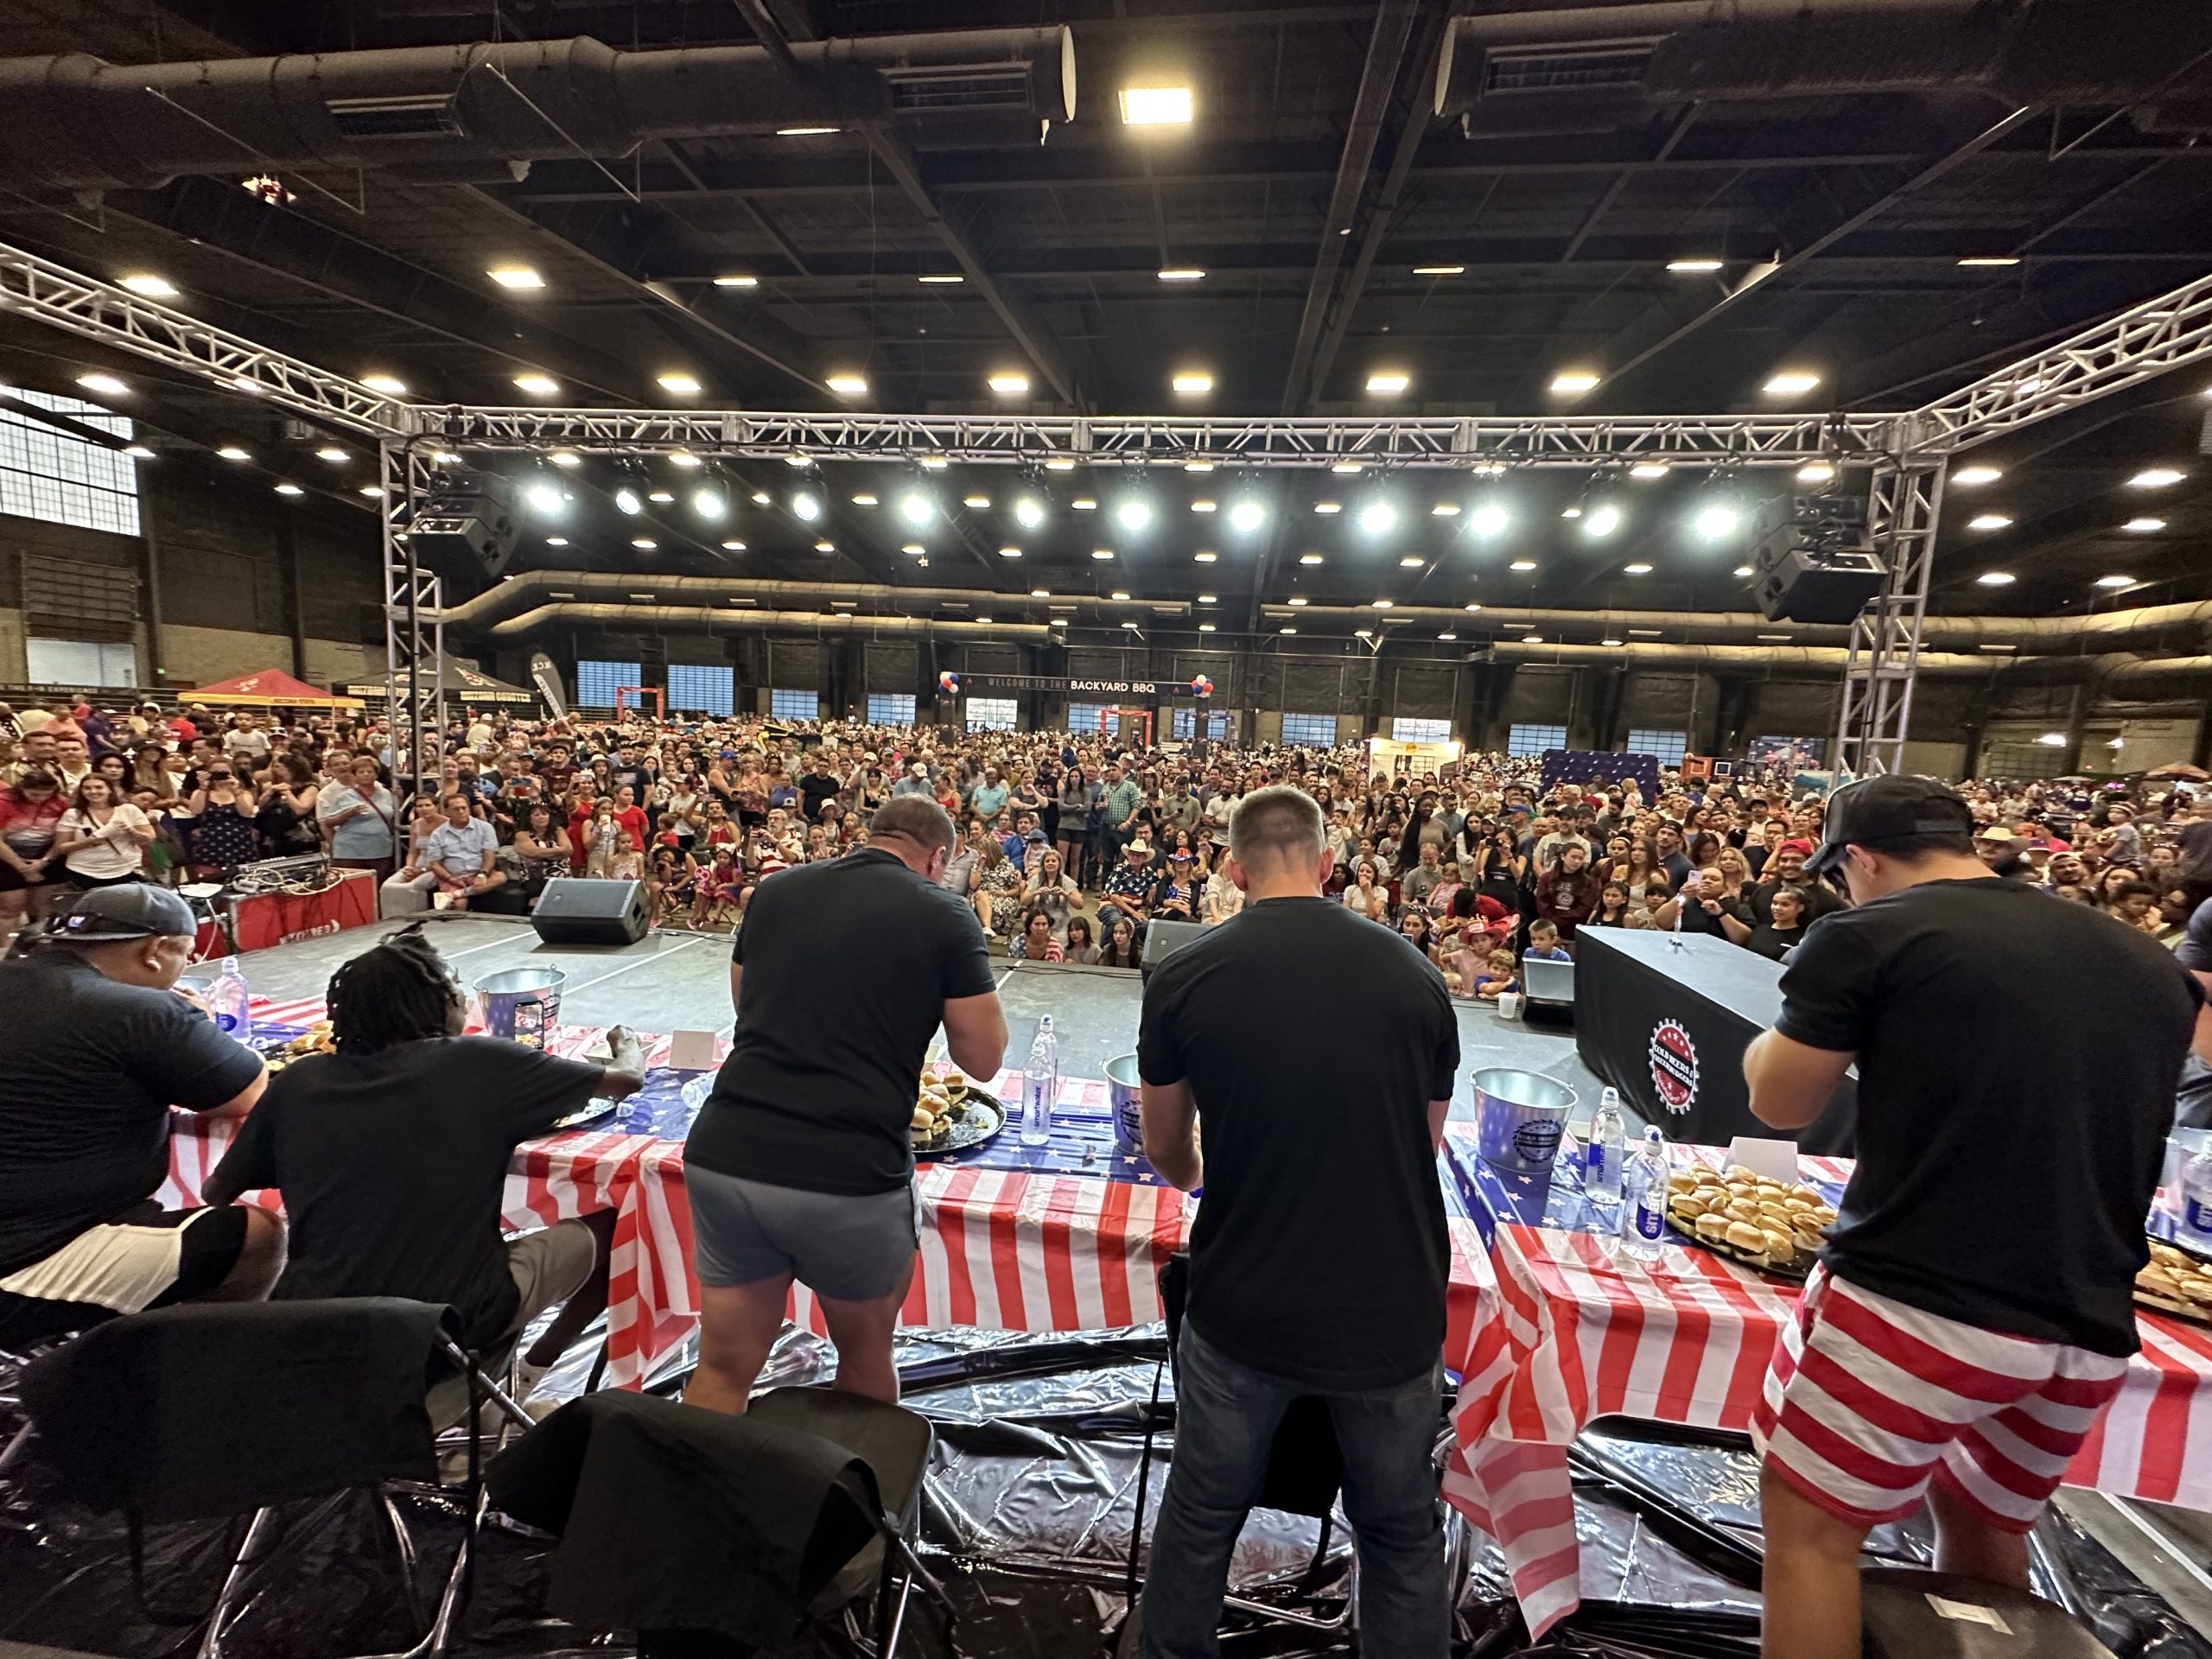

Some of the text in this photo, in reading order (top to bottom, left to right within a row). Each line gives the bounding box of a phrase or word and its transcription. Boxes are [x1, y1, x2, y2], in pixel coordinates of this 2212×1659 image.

[988, 677, 1156, 694] WELCOME TO THE BACKYARD BBQ
[1654, 1044, 1669, 1060] COLD
[1669, 1054, 1690, 1075] BEERS
